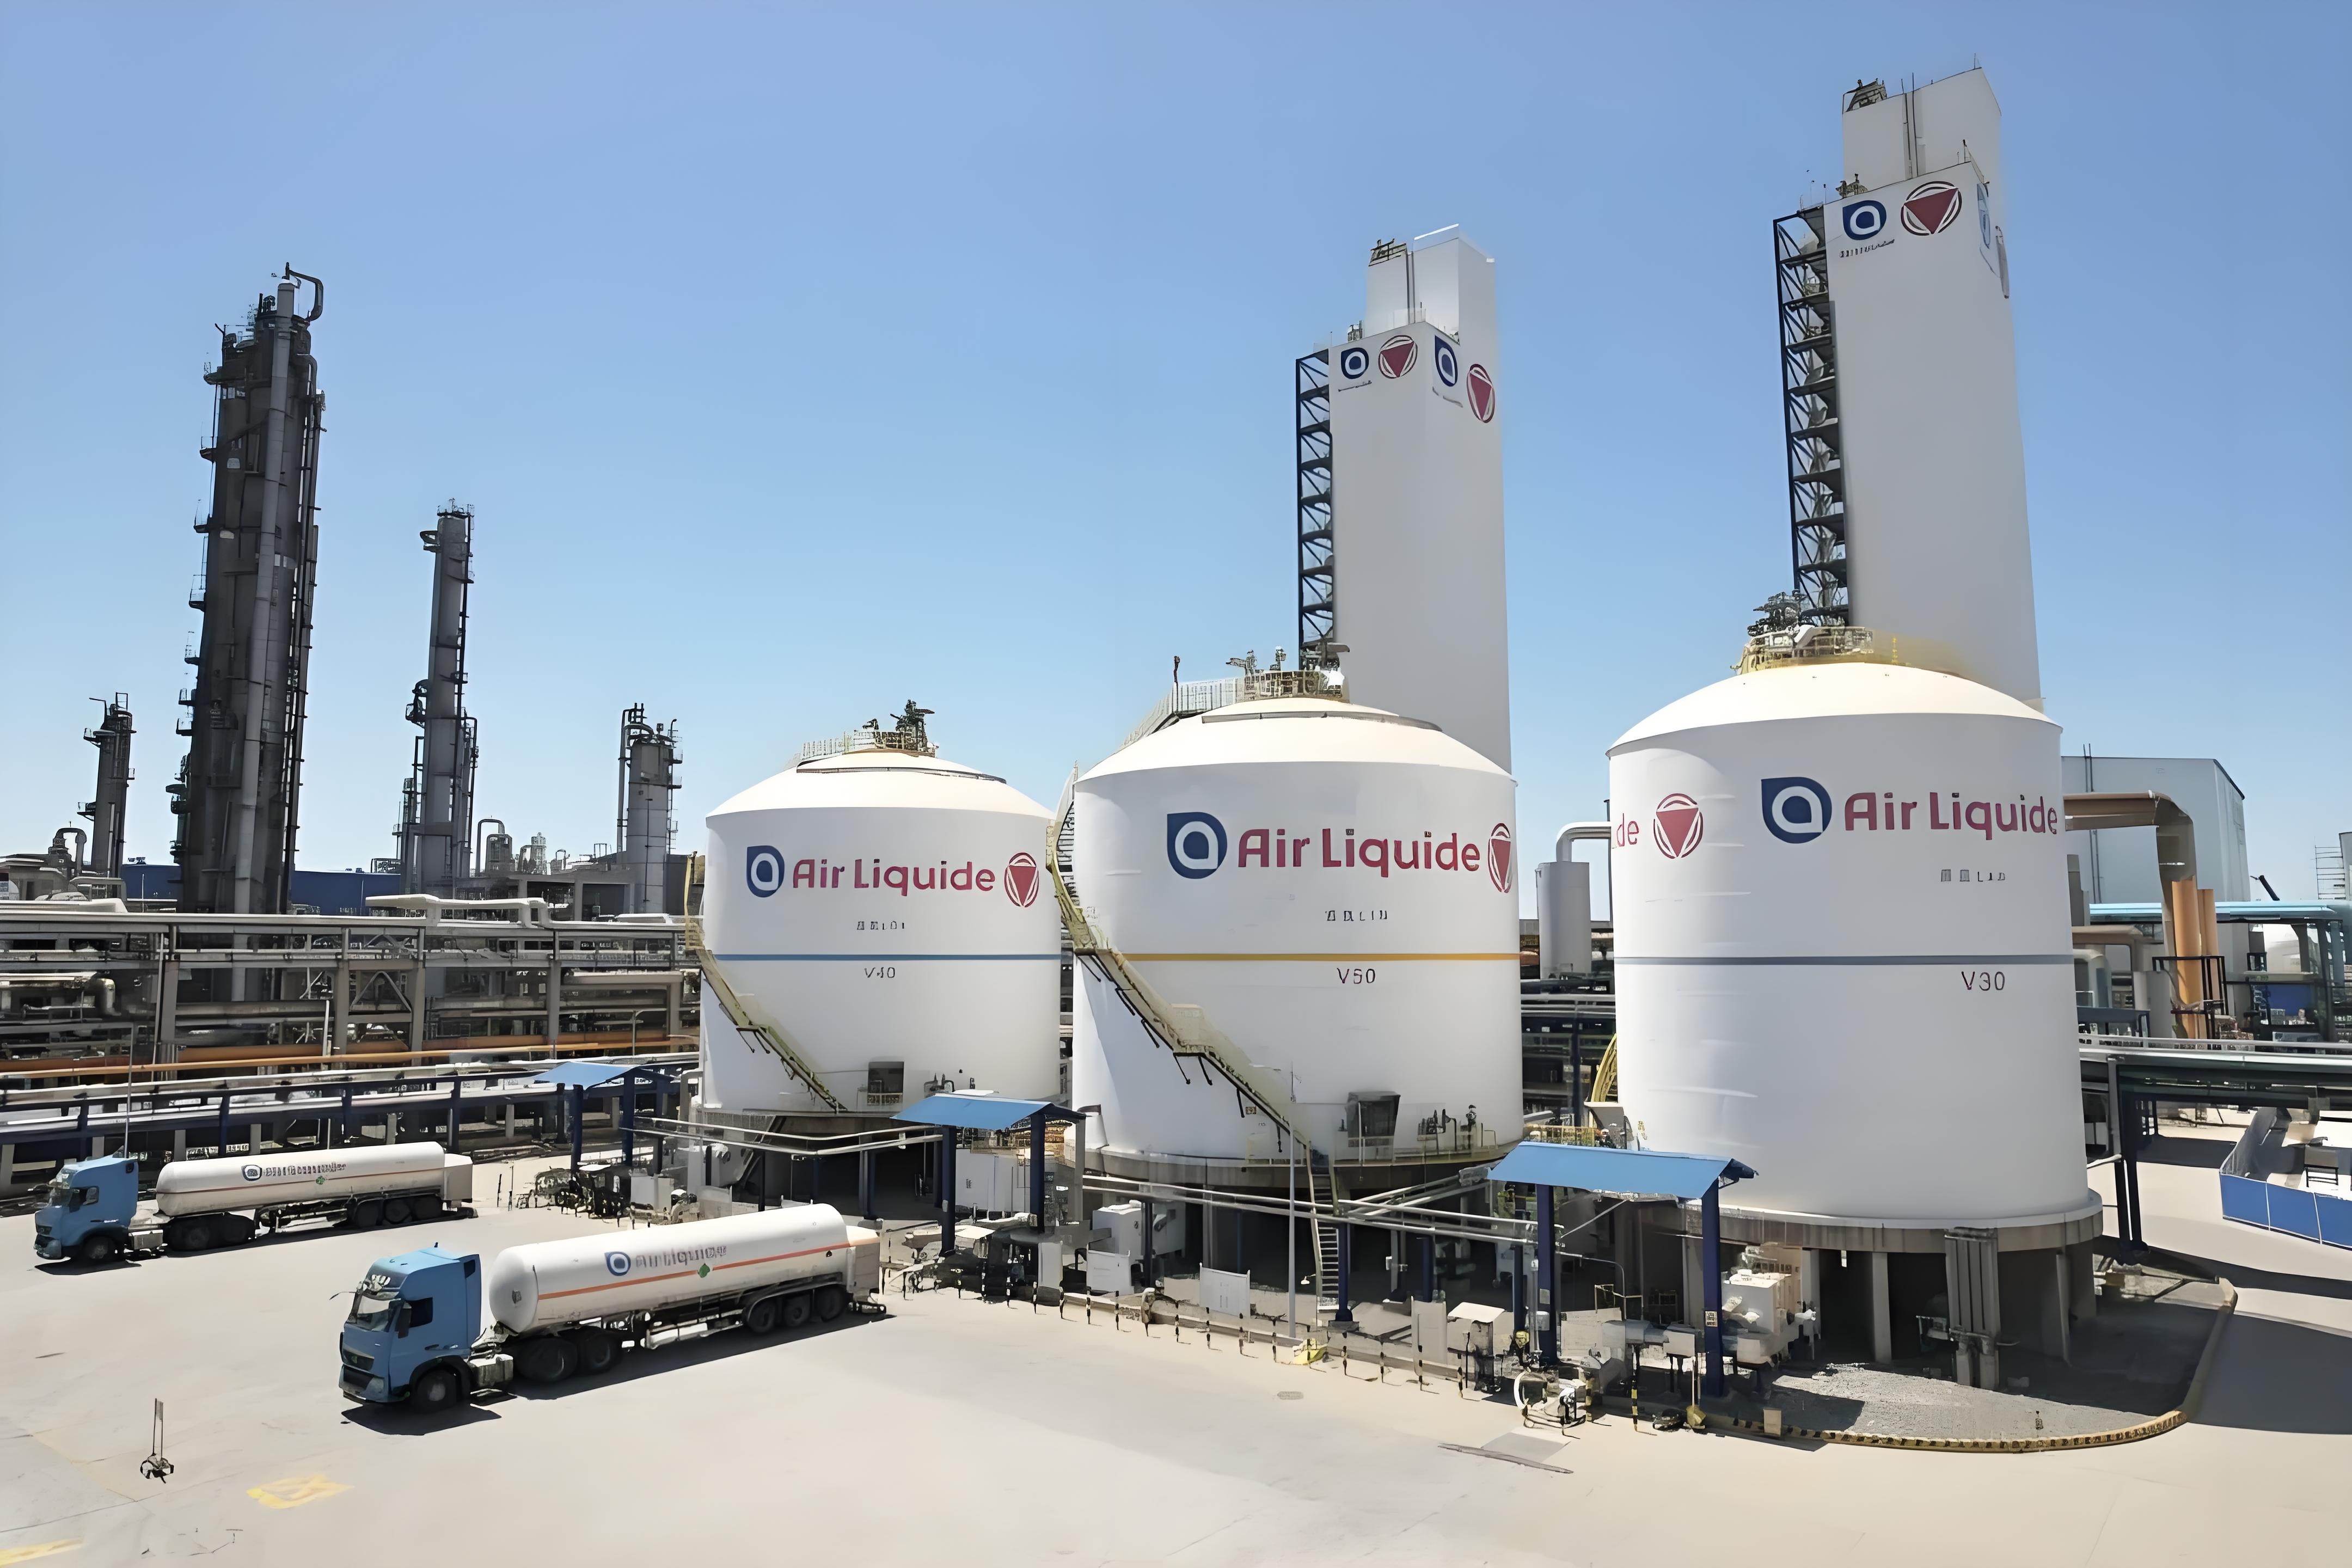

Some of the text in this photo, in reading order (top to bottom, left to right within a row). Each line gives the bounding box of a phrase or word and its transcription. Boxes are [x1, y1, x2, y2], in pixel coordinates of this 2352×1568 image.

[1845, 792, 2058, 840] Air Liquide
[1239, 828, 1480, 878] Air Liquide
[793, 859, 996, 897] Air Liquide
[1337, 967, 1376, 984] V50
[1961, 971, 2005, 991] V30
